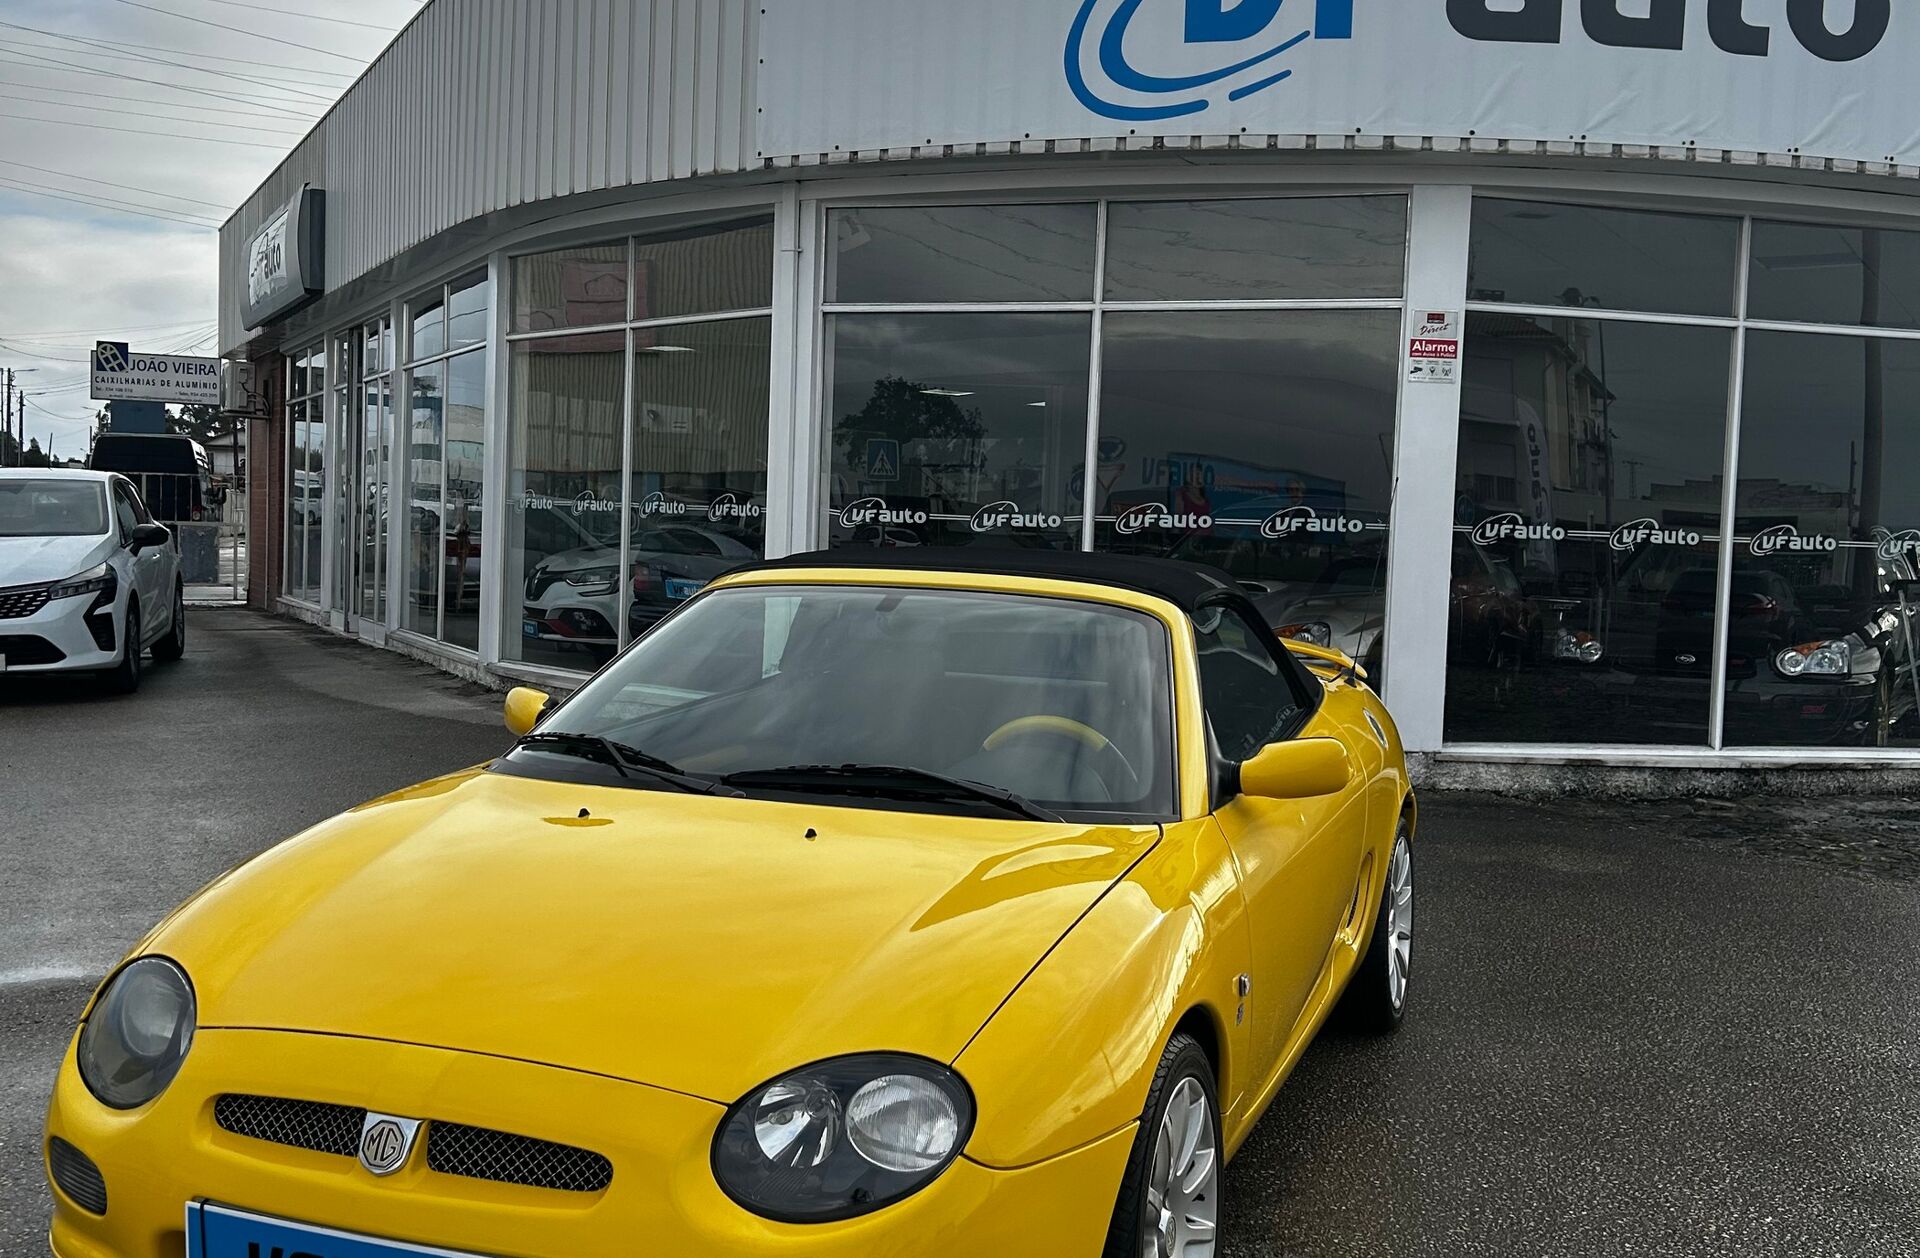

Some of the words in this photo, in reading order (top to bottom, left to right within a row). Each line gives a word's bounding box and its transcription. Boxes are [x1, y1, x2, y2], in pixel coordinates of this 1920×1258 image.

[1411, 340, 1456, 352] Alarme
[130, 357, 168, 373] JOÃO
[172, 361, 217, 376] VIEIRA
[94, 376, 156, 387] CAIXILHARIAS
[160, 379, 171, 388] DE
[175, 379, 218, 390] ALUMÍNIO
[577, 500, 614, 512] VFauto
[645, 502, 685, 514] VFauto
[715, 504, 760, 517] VFauto
[851, 507, 927, 524] VFauto
[982, 511, 1061, 528] VFauto
[1129, 511, 1212, 529] VFauto
[1275, 515, 1362, 533] VFauto
[1485, 522, 1565, 540] VFauto
[1622, 528, 1699, 544] VFauto
[1762, 533, 1836, 551] VFauto
[369, 1126, 399, 1162] MG
